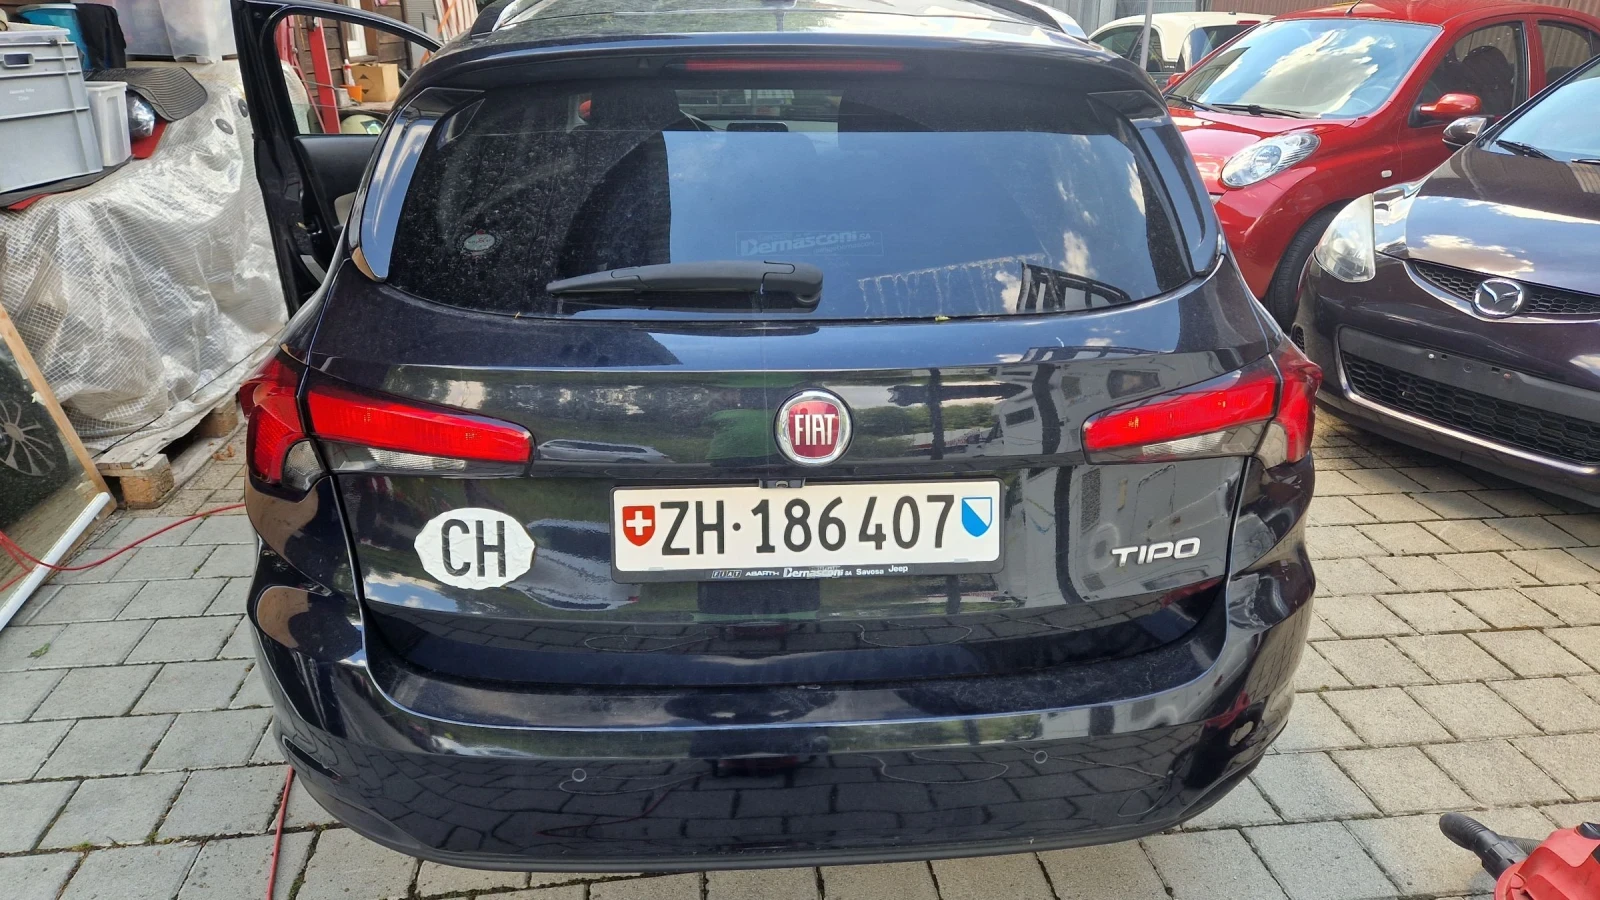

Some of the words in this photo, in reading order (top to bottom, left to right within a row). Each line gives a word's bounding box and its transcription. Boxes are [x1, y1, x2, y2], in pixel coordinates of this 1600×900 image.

[794, 413, 836, 446] FIAT
[441, 518, 507, 578] CH
[1111, 537, 1201, 567] TIPO
[711, 570, 742, 579] FIAT
[856, 568, 884, 576] Savosa
[888, 564, 909, 574] Jeep
